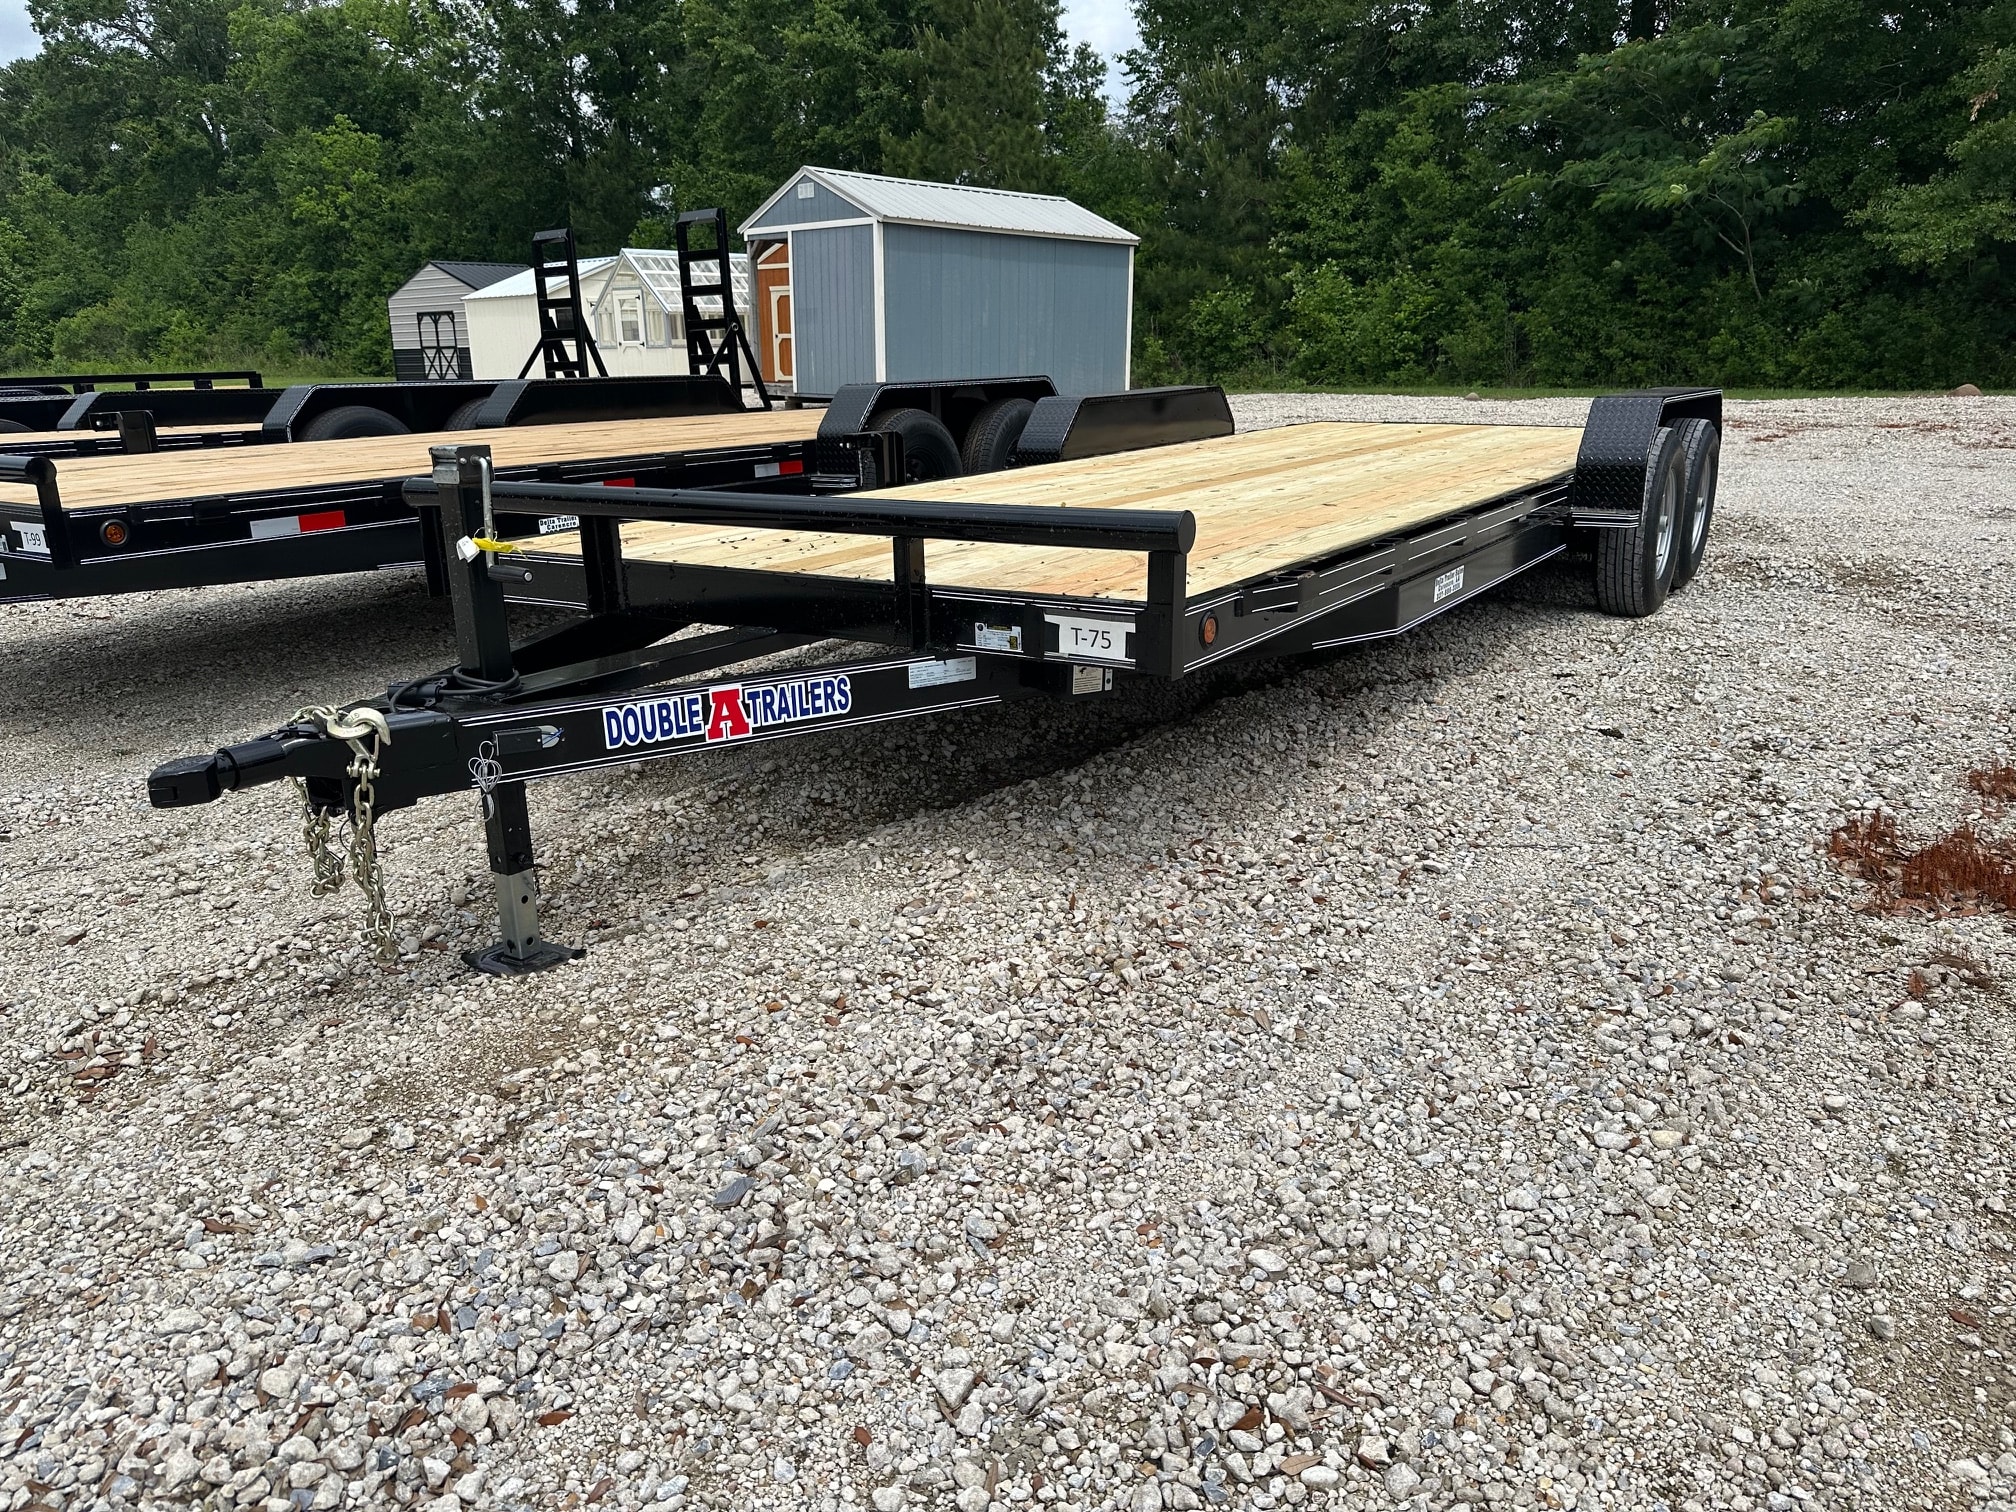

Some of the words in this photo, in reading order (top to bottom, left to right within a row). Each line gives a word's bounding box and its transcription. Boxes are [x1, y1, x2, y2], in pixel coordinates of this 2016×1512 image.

[23, 532, 41, 546] T-99
[1070, 626, 1112, 650] T-75
[604, 696, 703, 747] DOUBLE
[707, 687, 750, 741] A
[746, 676, 851, 725] TRAILERS
